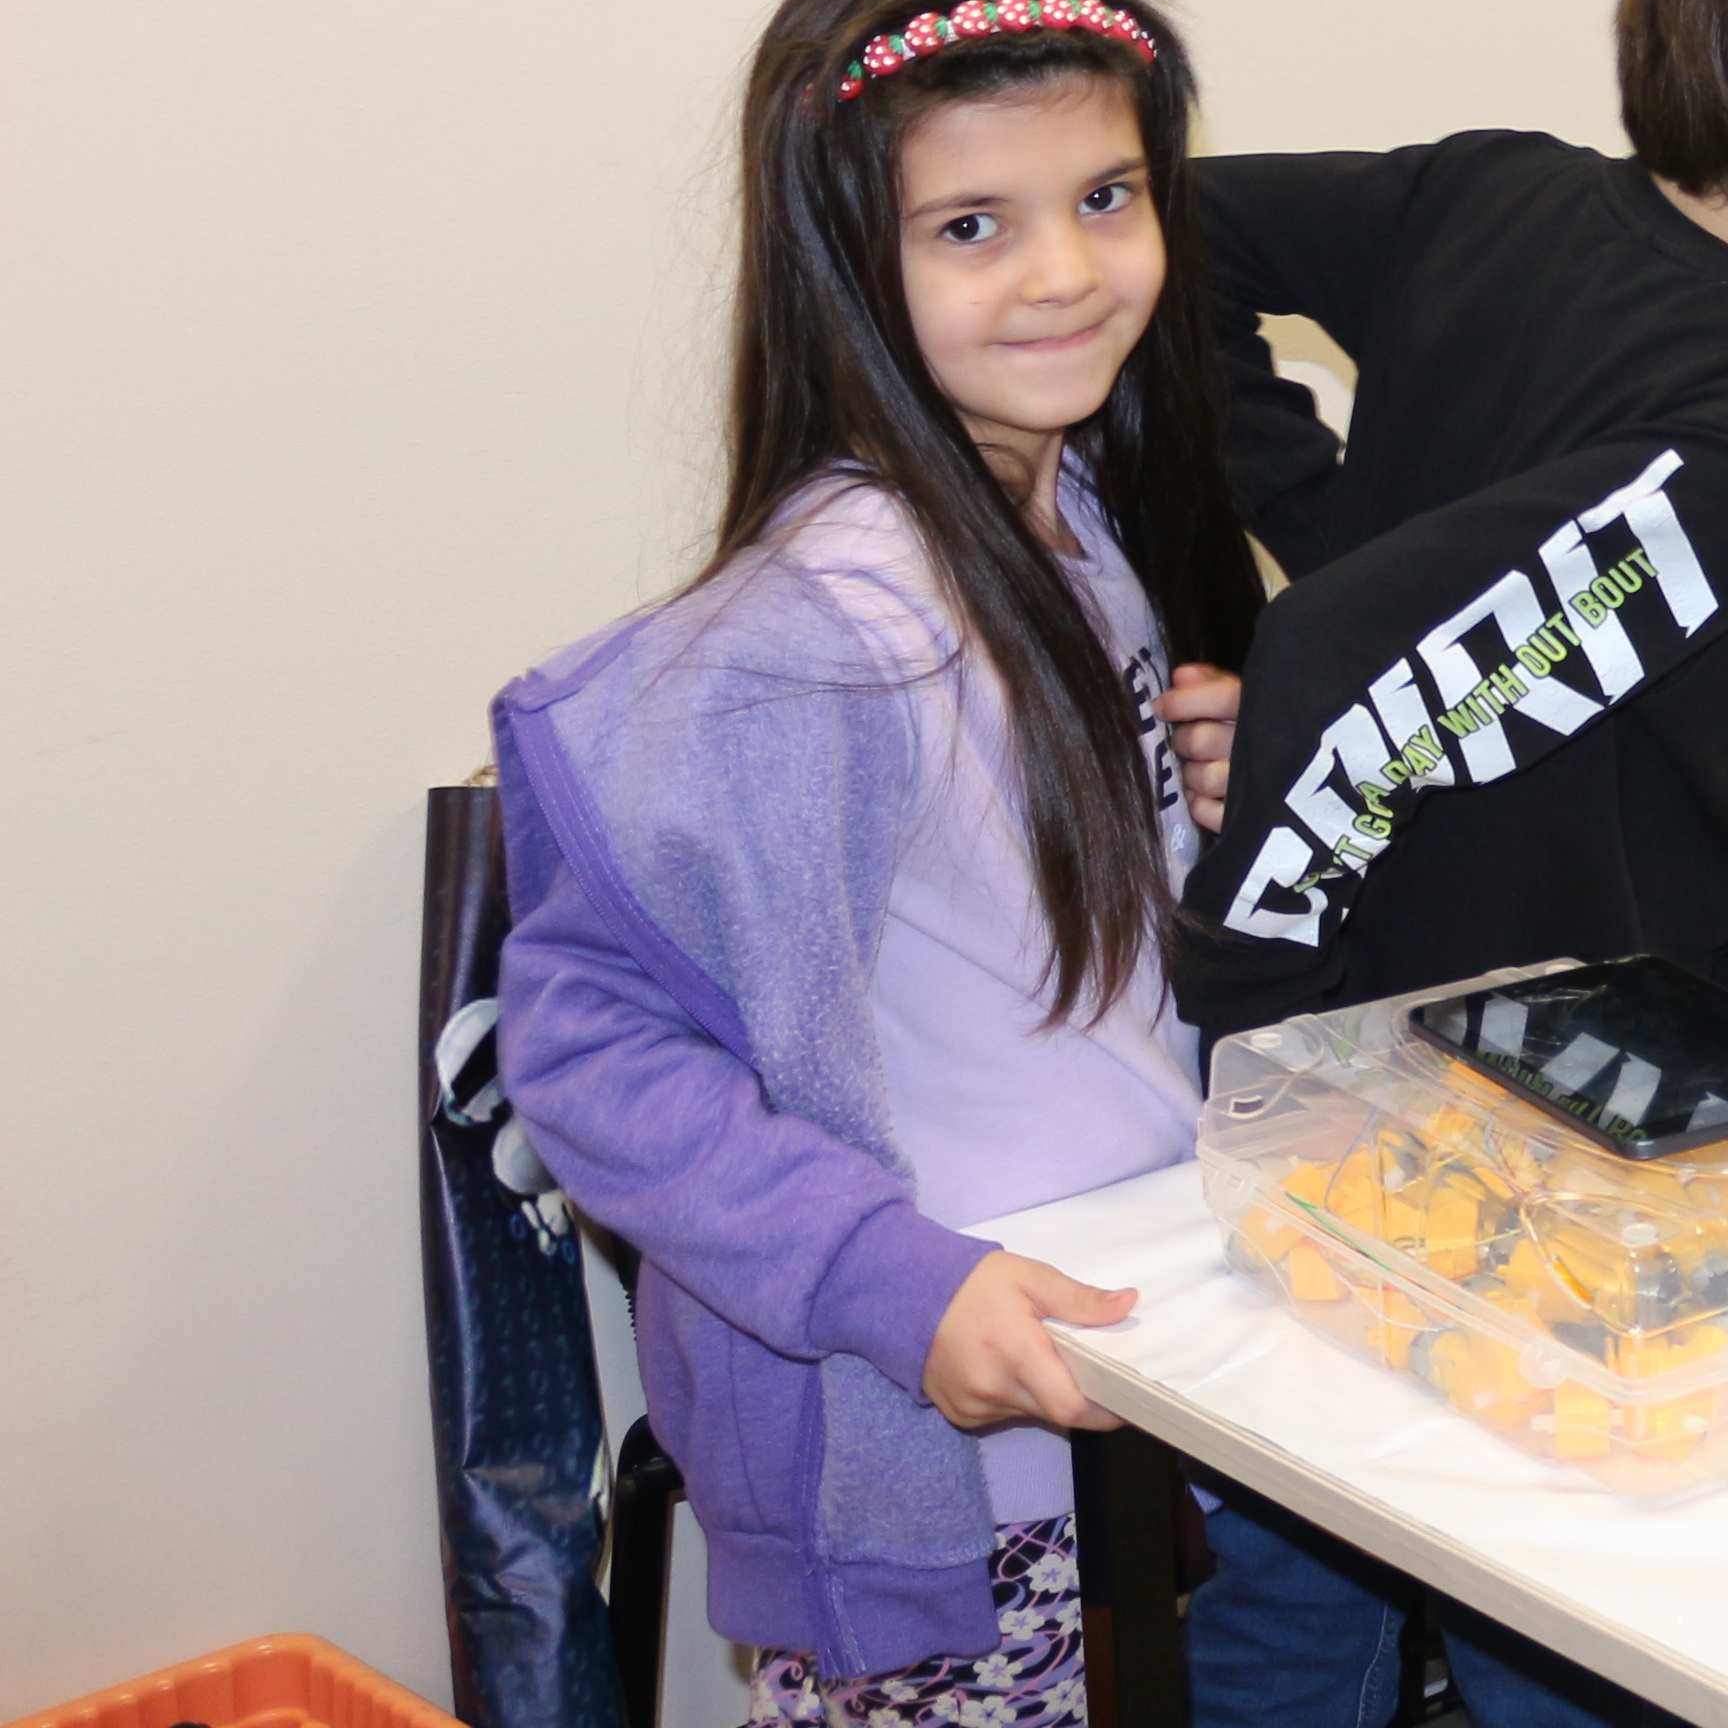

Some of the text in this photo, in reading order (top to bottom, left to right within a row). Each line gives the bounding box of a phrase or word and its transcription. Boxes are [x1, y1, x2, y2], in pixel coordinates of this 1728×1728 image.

[1437, 663, 1529, 740] WITH
[1514, 611, 1582, 678] OUT
[1568, 547, 1661, 629] BOUT
